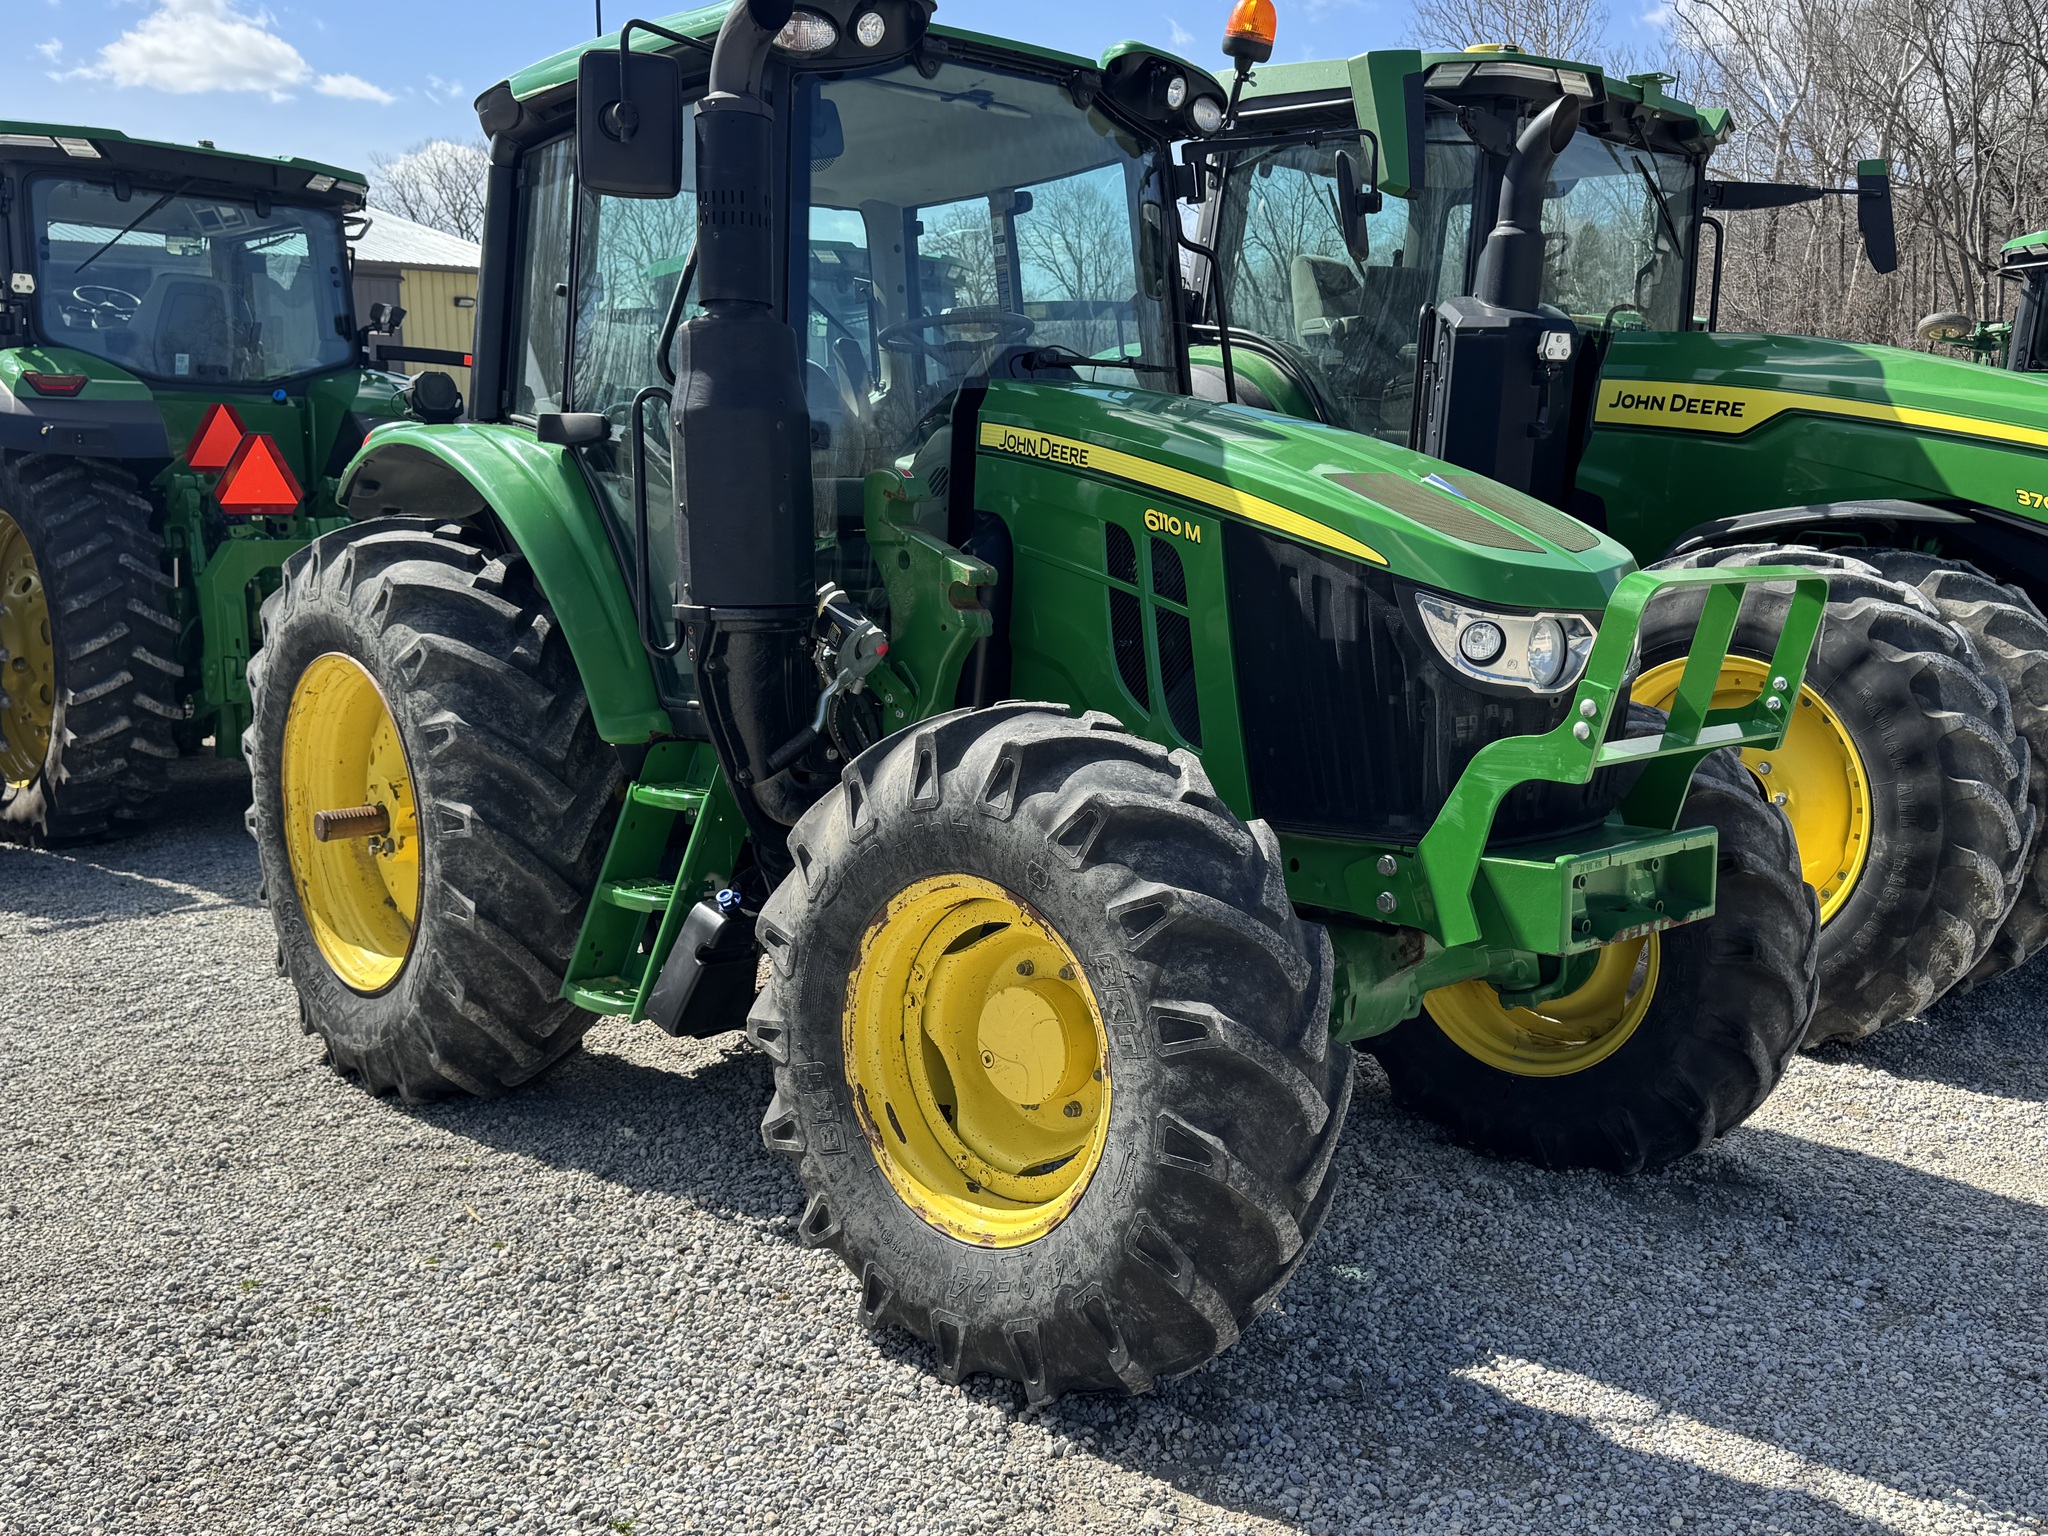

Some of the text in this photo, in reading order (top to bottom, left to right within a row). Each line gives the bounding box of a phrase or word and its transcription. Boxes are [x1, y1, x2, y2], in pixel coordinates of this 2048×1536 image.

[1609, 391, 1746, 417] JOHN DEERE
[999, 430, 1089, 465] JOHN DEERE
[1144, 508, 1202, 543] 6110 M
[1857, 683, 1907, 771] RADIAL
[1897, 783, 1917, 828] ALL
[1089, 951, 1148, 1060] BKT
[796, 1061, 848, 1155] BKT
